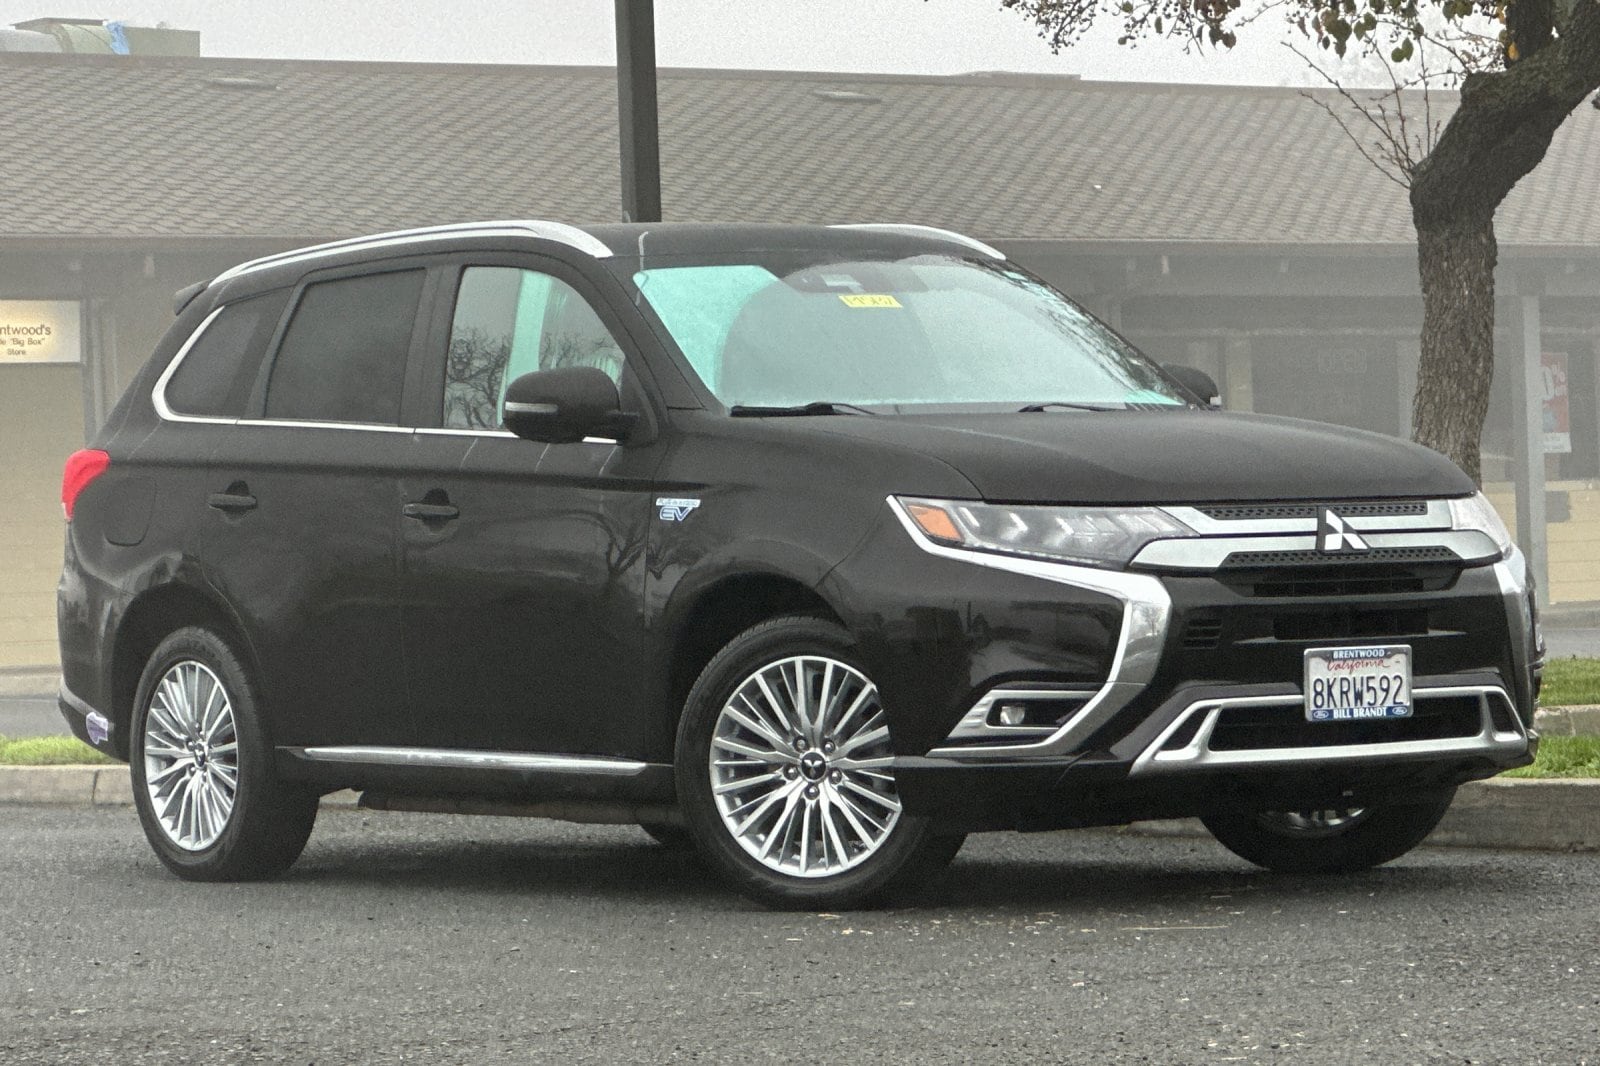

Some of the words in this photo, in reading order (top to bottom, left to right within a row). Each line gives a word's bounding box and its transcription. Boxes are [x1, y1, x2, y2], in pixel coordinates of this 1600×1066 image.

[660, 506, 693, 521] EV
[1333, 649, 1385, 659] BRENTWOOD
[1313, 675, 1404, 709] 8KRW592
[1333, 708, 1351, 719] BILL
[1353, 706, 1388, 717] BRANDT
